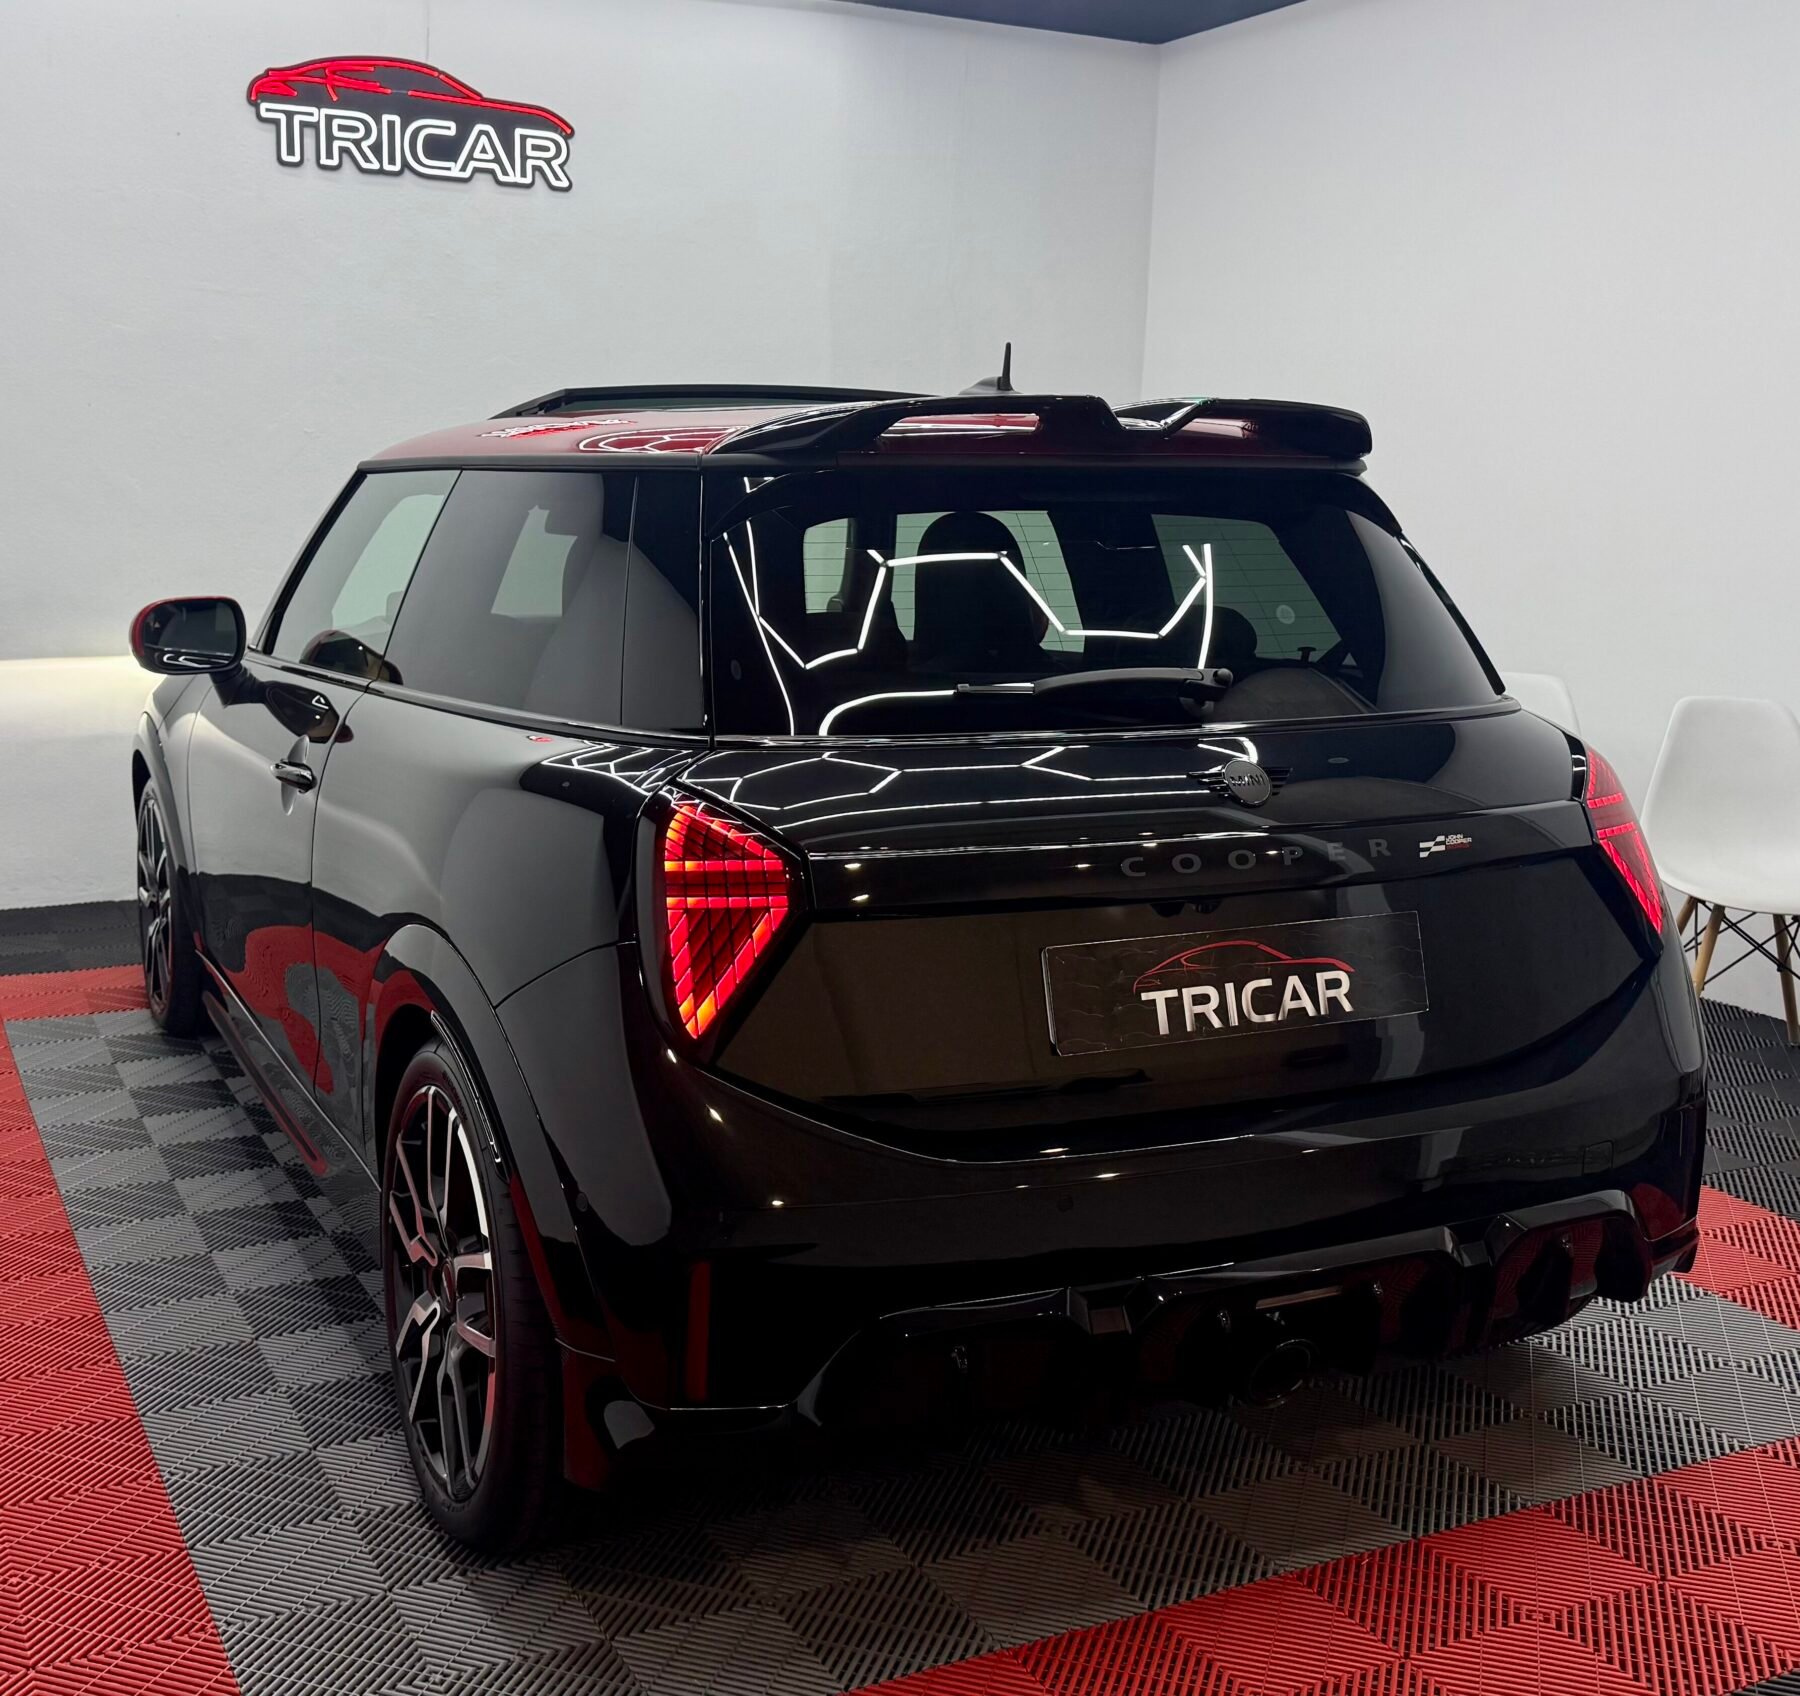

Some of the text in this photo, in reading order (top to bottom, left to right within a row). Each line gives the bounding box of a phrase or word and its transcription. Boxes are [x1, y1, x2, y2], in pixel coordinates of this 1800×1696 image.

[260, 103, 570, 187] TRICAR
[1230, 774, 1266, 787] MINI
[1121, 838, 1391, 877] COOPER
[1140, 970, 1354, 1035] TRICAR
